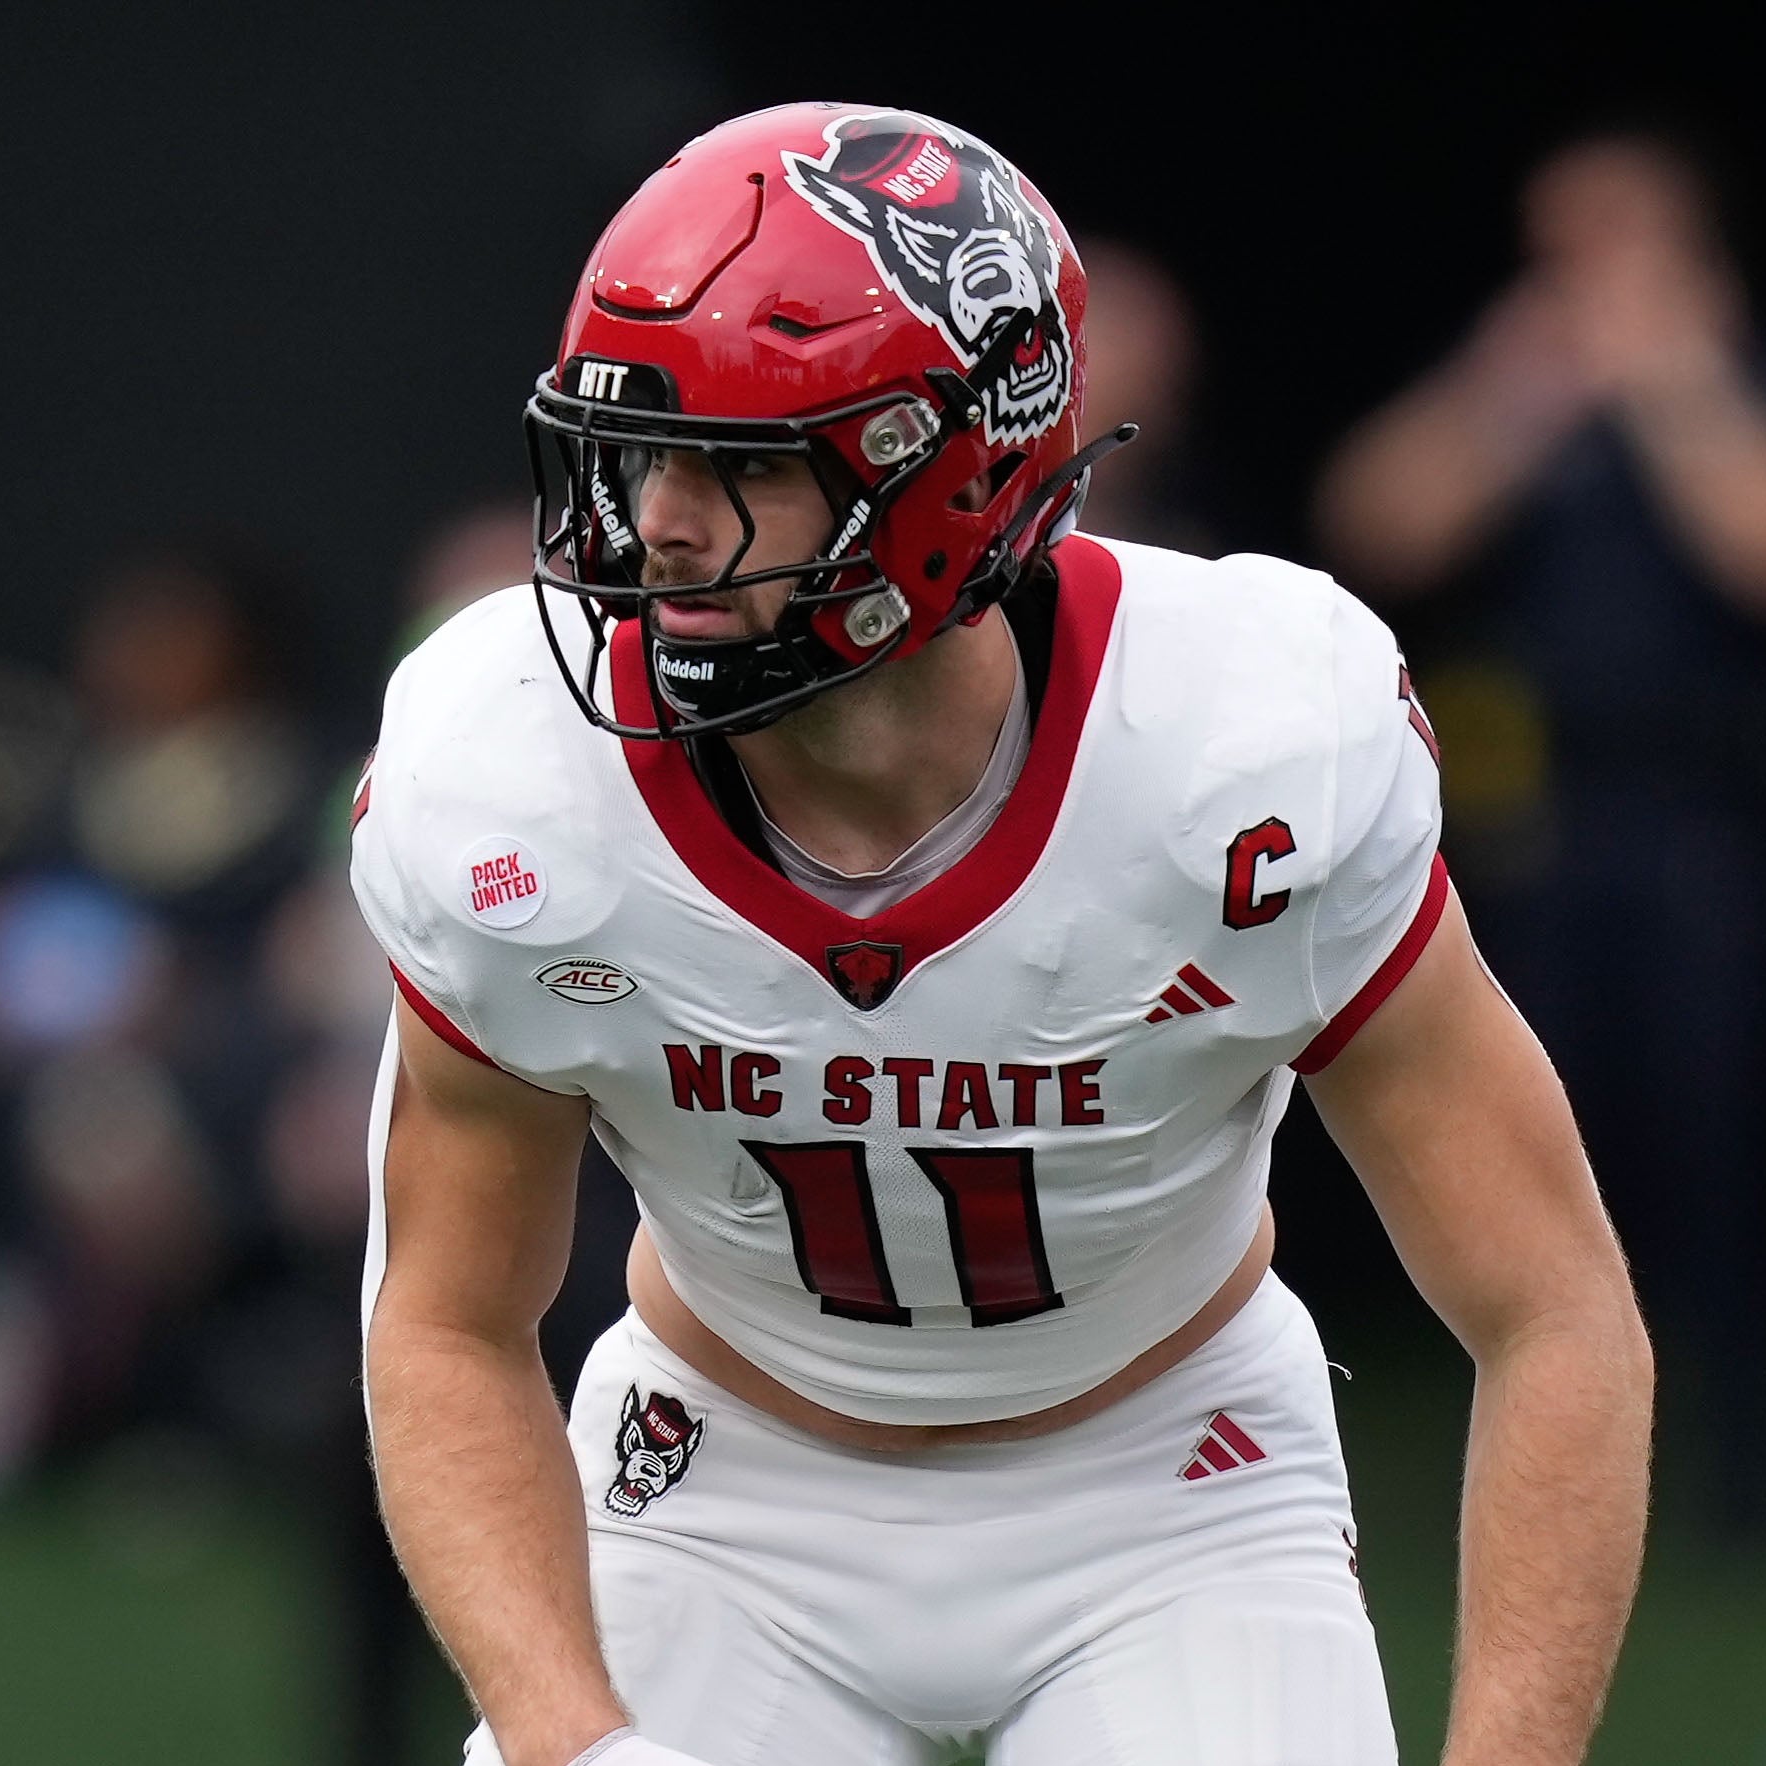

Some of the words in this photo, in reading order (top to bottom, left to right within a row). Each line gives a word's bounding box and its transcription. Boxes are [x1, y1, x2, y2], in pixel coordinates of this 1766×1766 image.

[882, 173, 926, 203] NC
[906, 139, 952, 187] STATE
[578, 361, 629, 401] HTT
[658, 653, 715, 681] Riddell
[471, 852, 521, 888] PACK
[1223, 816, 1297, 931] C
[471, 872, 538, 912] UNITED
[552, 970, 624, 989] ACC
[662, 1044, 784, 1118] NC
[822, 1056, 1109, 1130] STATE
[738, 1139, 1065, 1328] 11
[647, 1410, 660, 1427] NC
[655, 1421, 680, 1443] STATE
